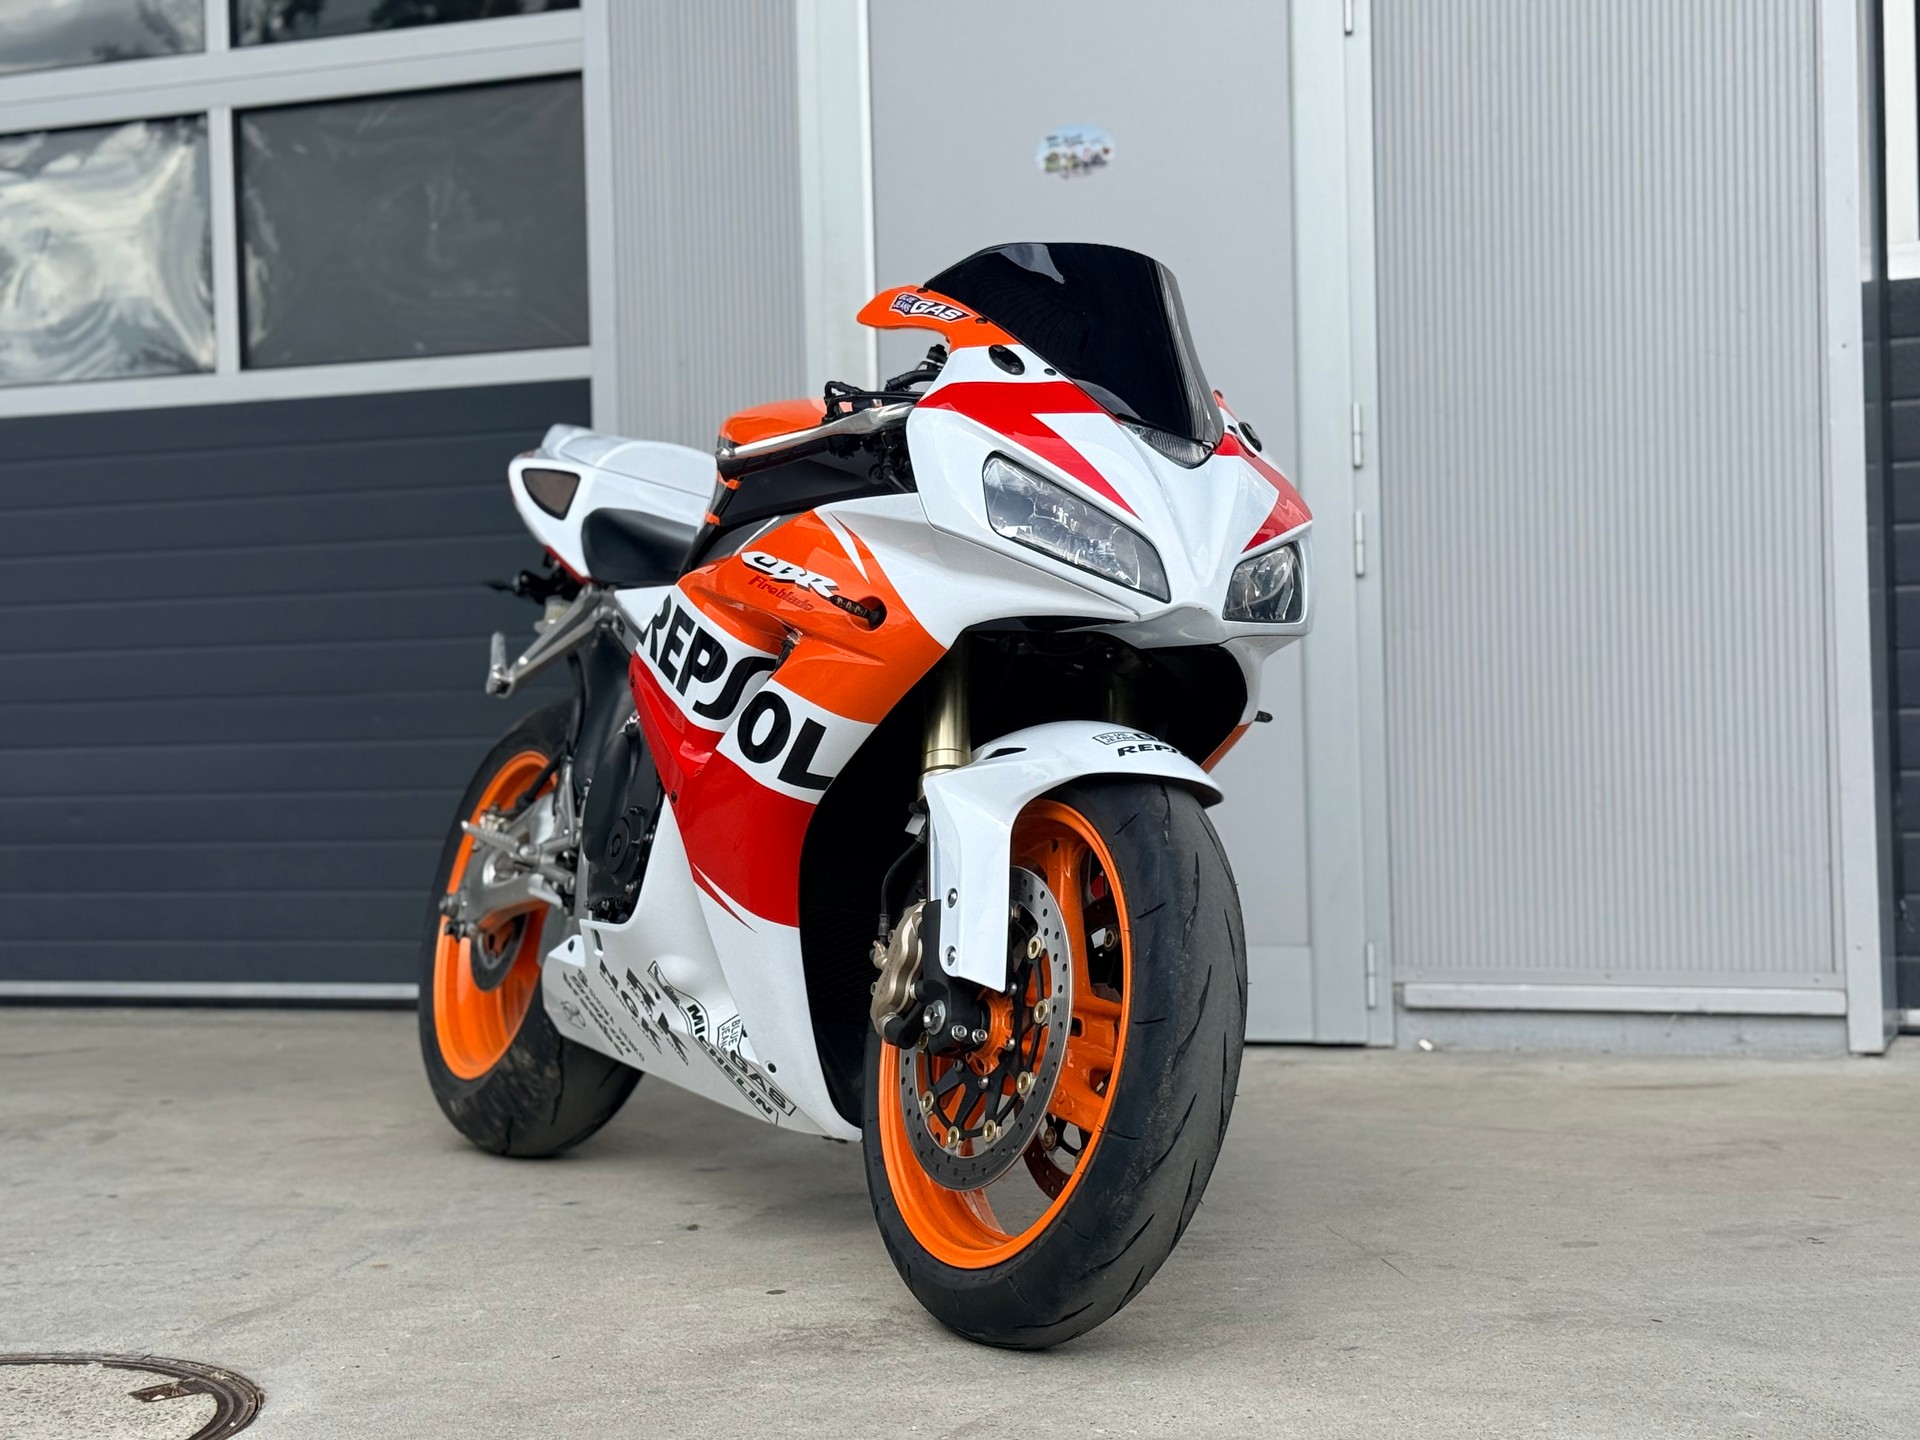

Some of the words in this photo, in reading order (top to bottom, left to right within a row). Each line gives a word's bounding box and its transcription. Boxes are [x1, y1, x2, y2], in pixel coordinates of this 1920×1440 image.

[910, 301, 963, 320] GAS
[741, 551, 839, 599] CBR
[747, 575, 814, 611] Fireblade
[639, 594, 835, 791] REPSOL
[599, 958, 662, 1054] NGK
[626, 967, 689, 1062] RK
[728, 1019, 741, 1047] BLUE
[687, 1004, 773, 1115] MICHELIN
[720, 1025, 730, 1055] JEANS
[730, 1049, 786, 1109] GAS
